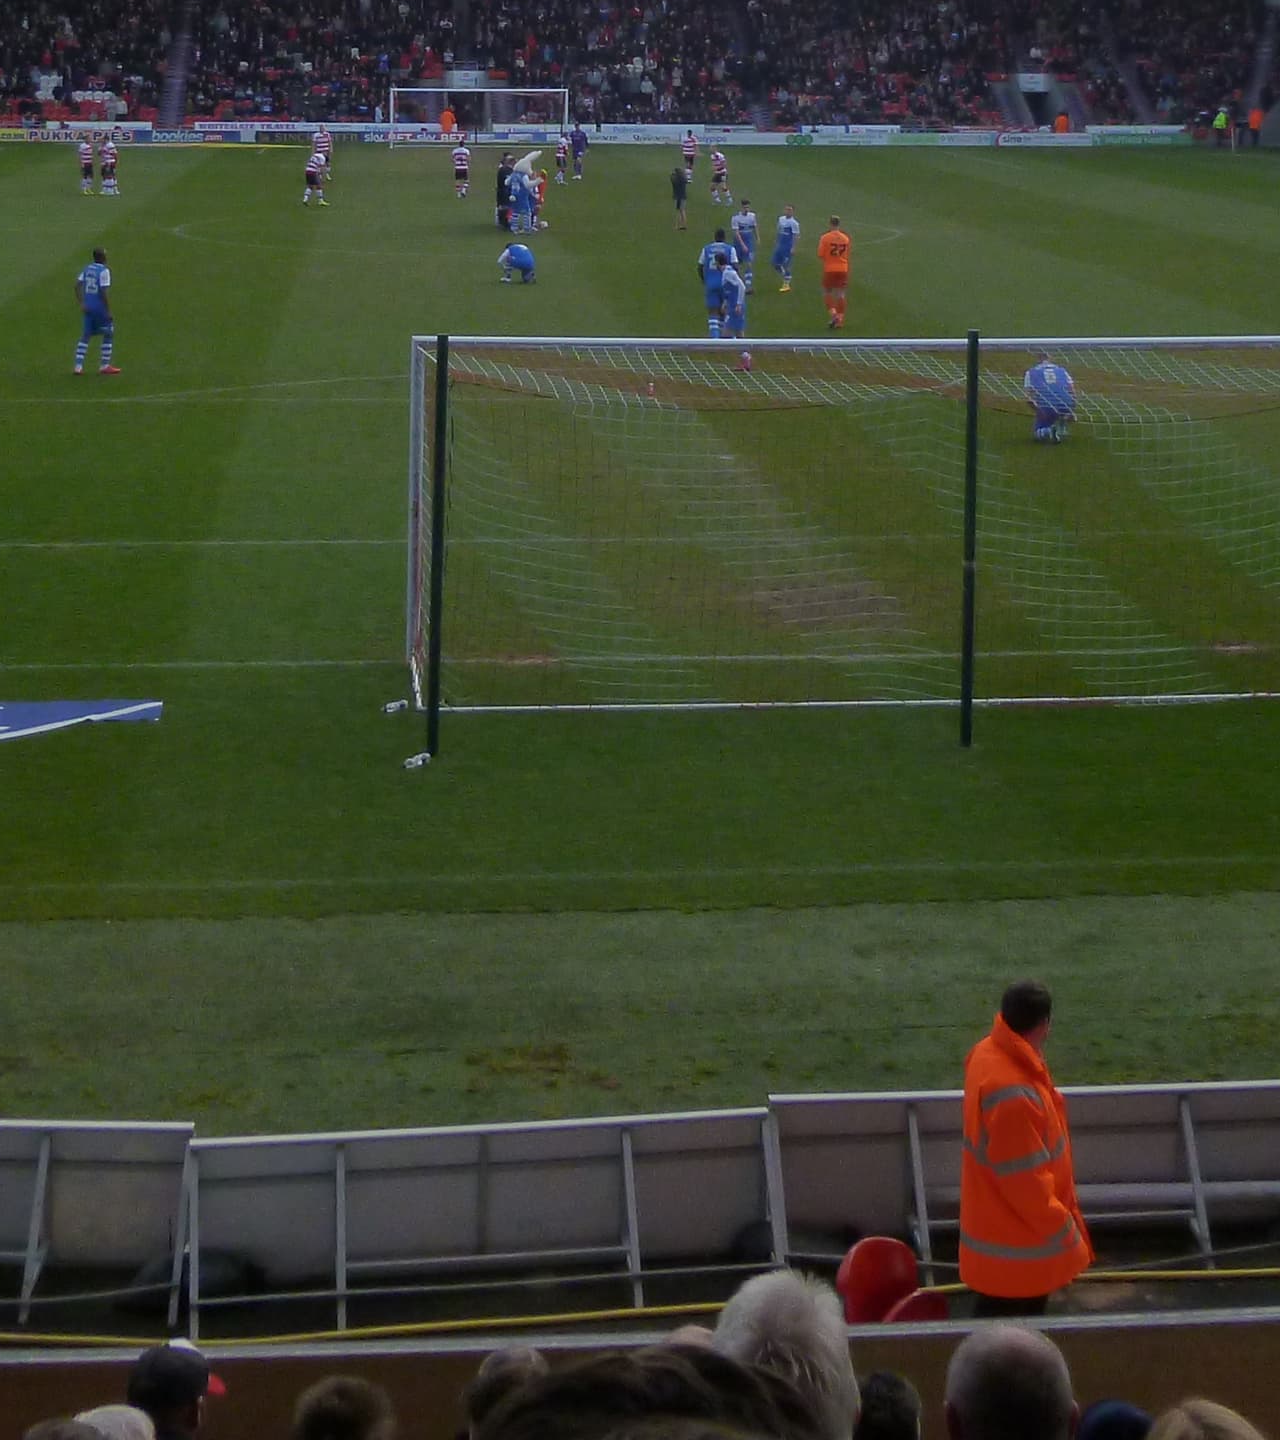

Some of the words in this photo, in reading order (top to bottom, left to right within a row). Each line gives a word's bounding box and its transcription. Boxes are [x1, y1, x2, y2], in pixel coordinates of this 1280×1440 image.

[29, 131, 87, 141] PUKKA
[93, 131, 131, 141] PIES
[441, 133, 464, 142] BET
